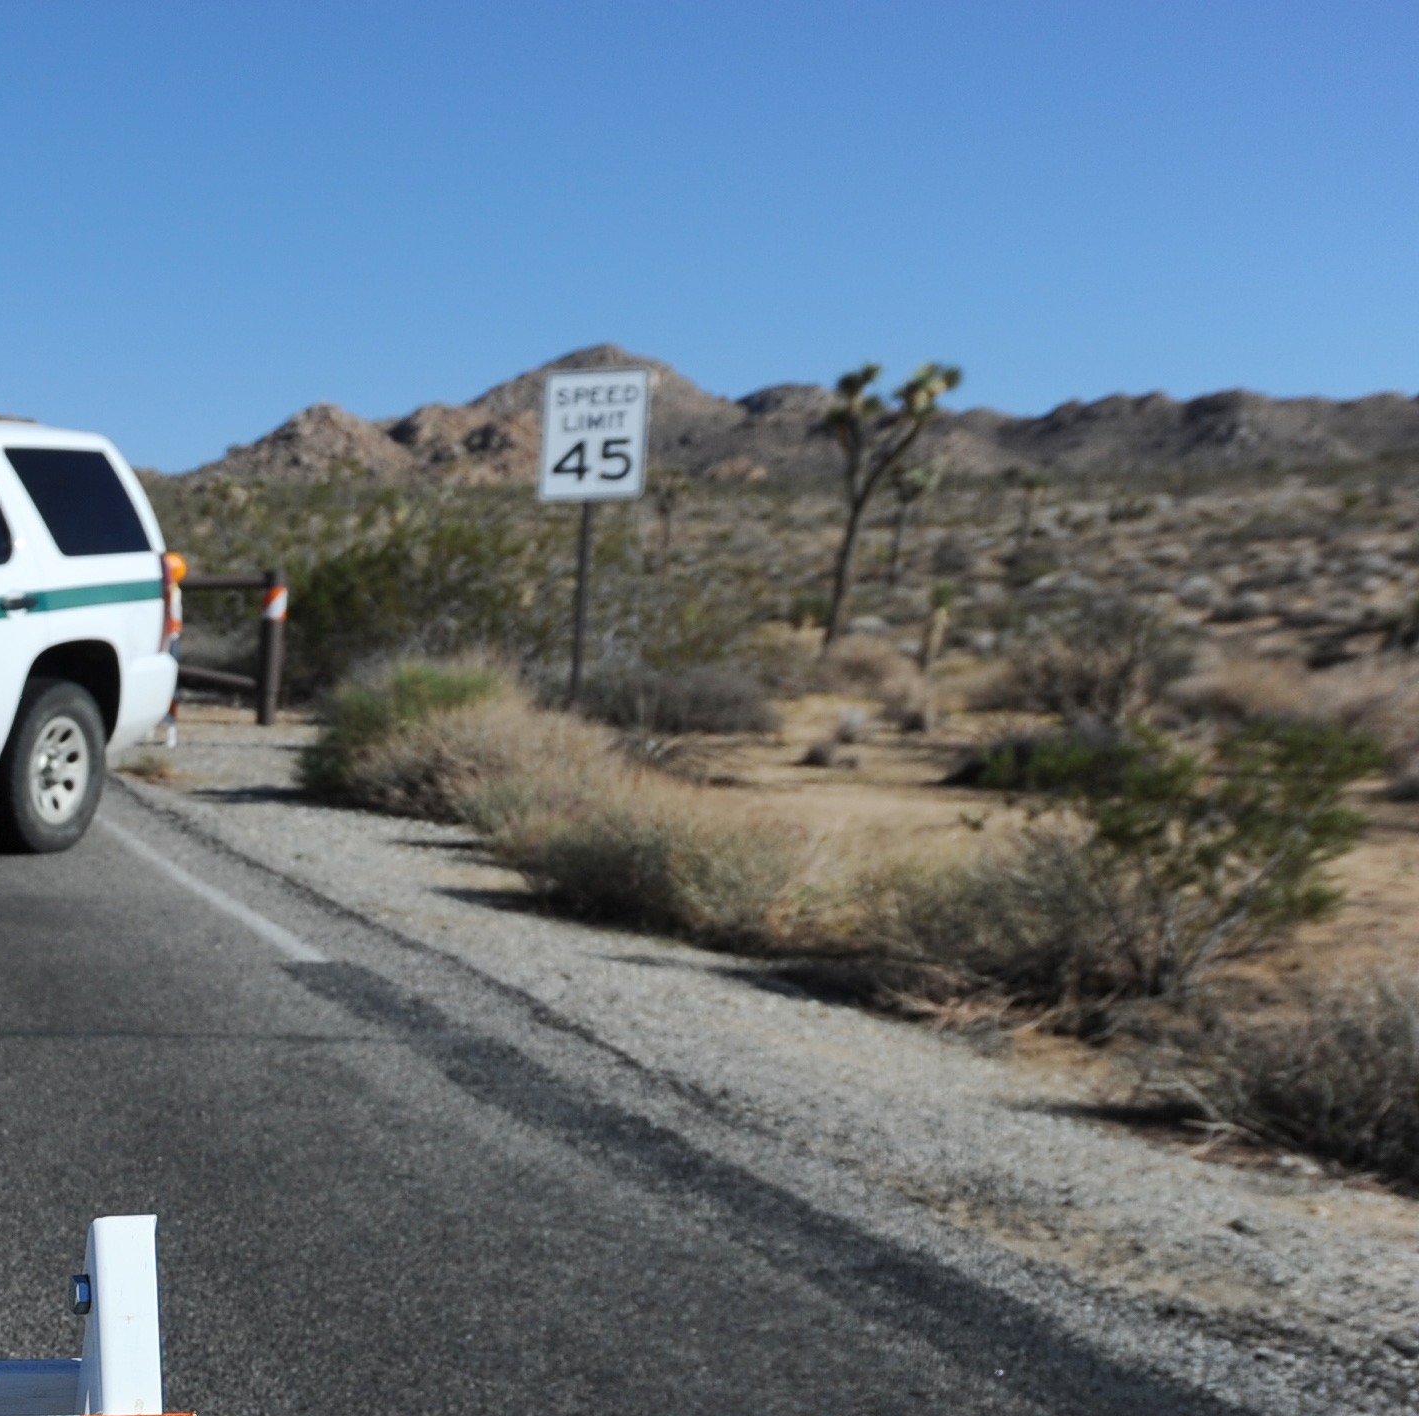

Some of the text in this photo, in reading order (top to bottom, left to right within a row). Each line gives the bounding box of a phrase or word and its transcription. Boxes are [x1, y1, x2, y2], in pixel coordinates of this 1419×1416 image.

[556, 384, 640, 406] SPEED
[562, 410, 627, 433] LIMIT
[552, 438, 632, 481] 45
